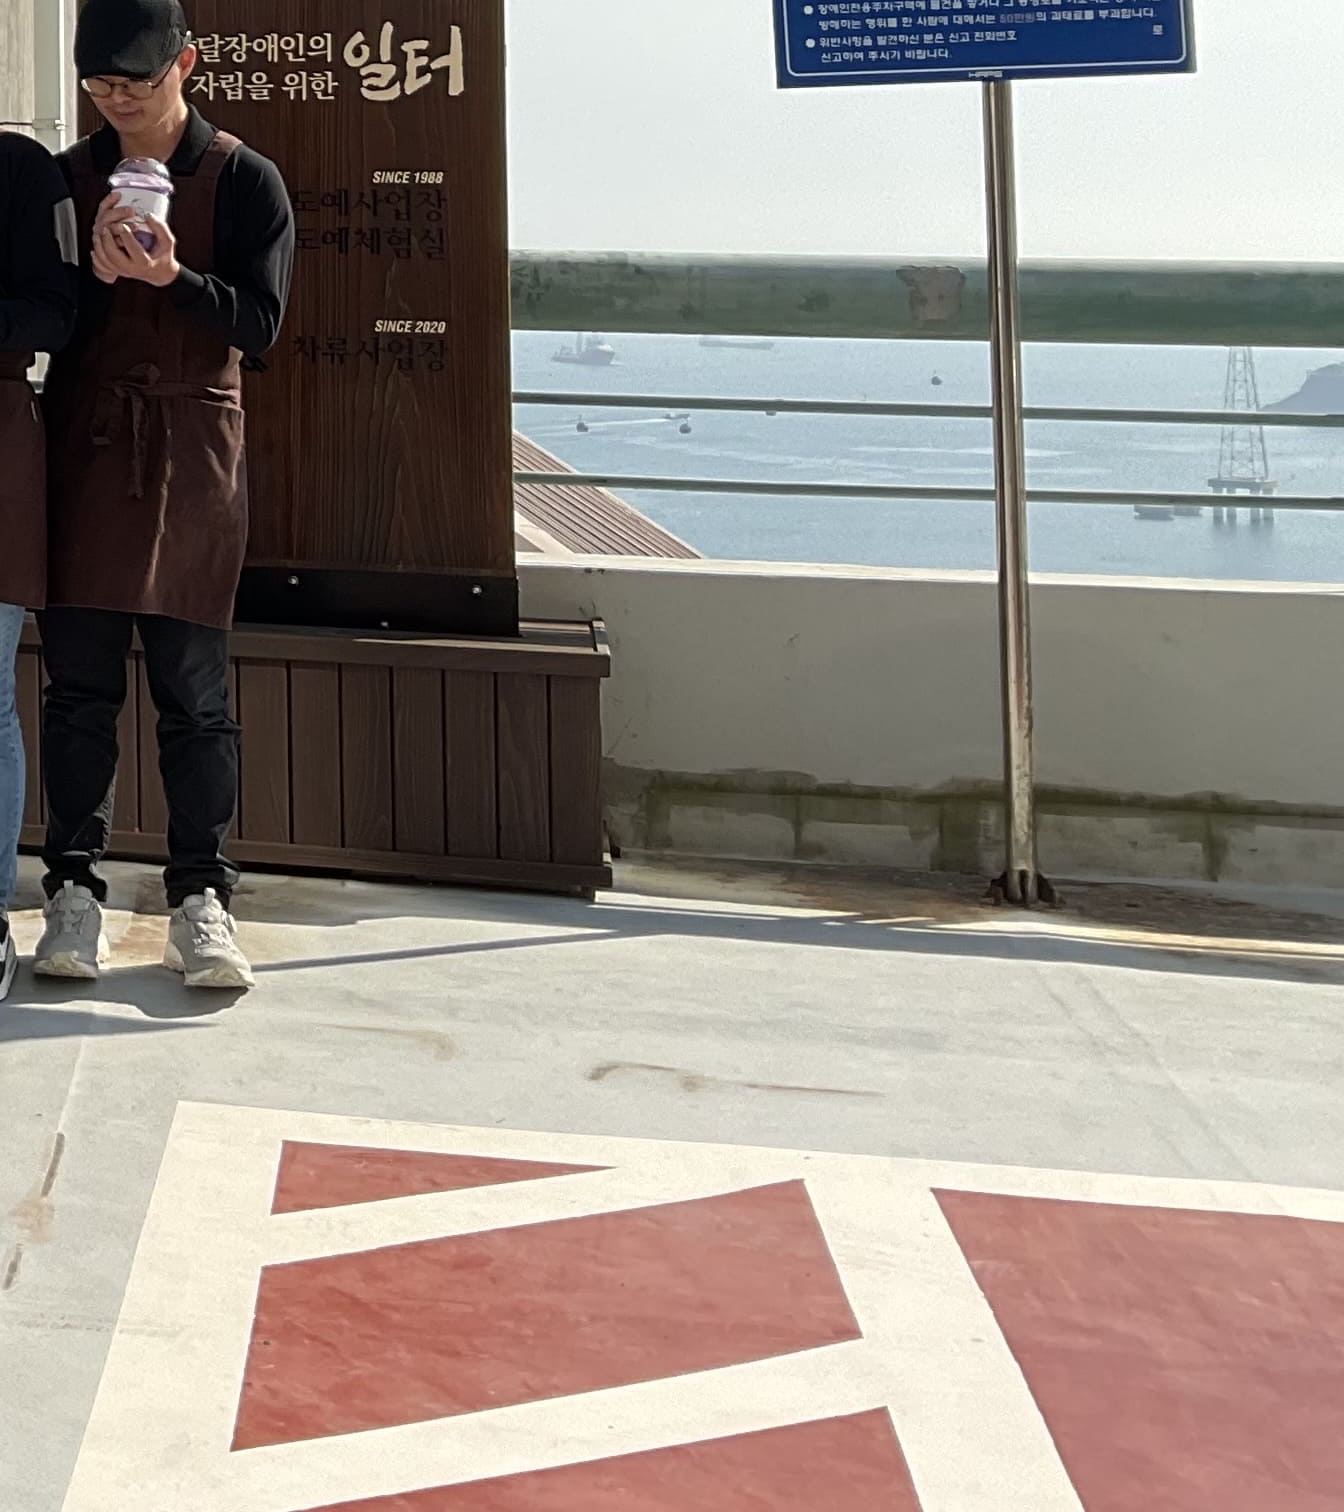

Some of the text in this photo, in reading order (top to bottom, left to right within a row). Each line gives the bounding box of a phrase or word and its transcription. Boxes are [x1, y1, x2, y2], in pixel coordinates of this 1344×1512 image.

[192, 32, 332, 63] 달장애인의
[343, 21, 465, 102] 일터
[190, 70, 339, 101] 자립을 위한
[372, 171, 444, 184] SINCE 1988
[293, 188, 448, 222] 도예사업장
[294, 226, 447, 261] 도예체험실
[374, 320, 446, 334] SINCE 2020
